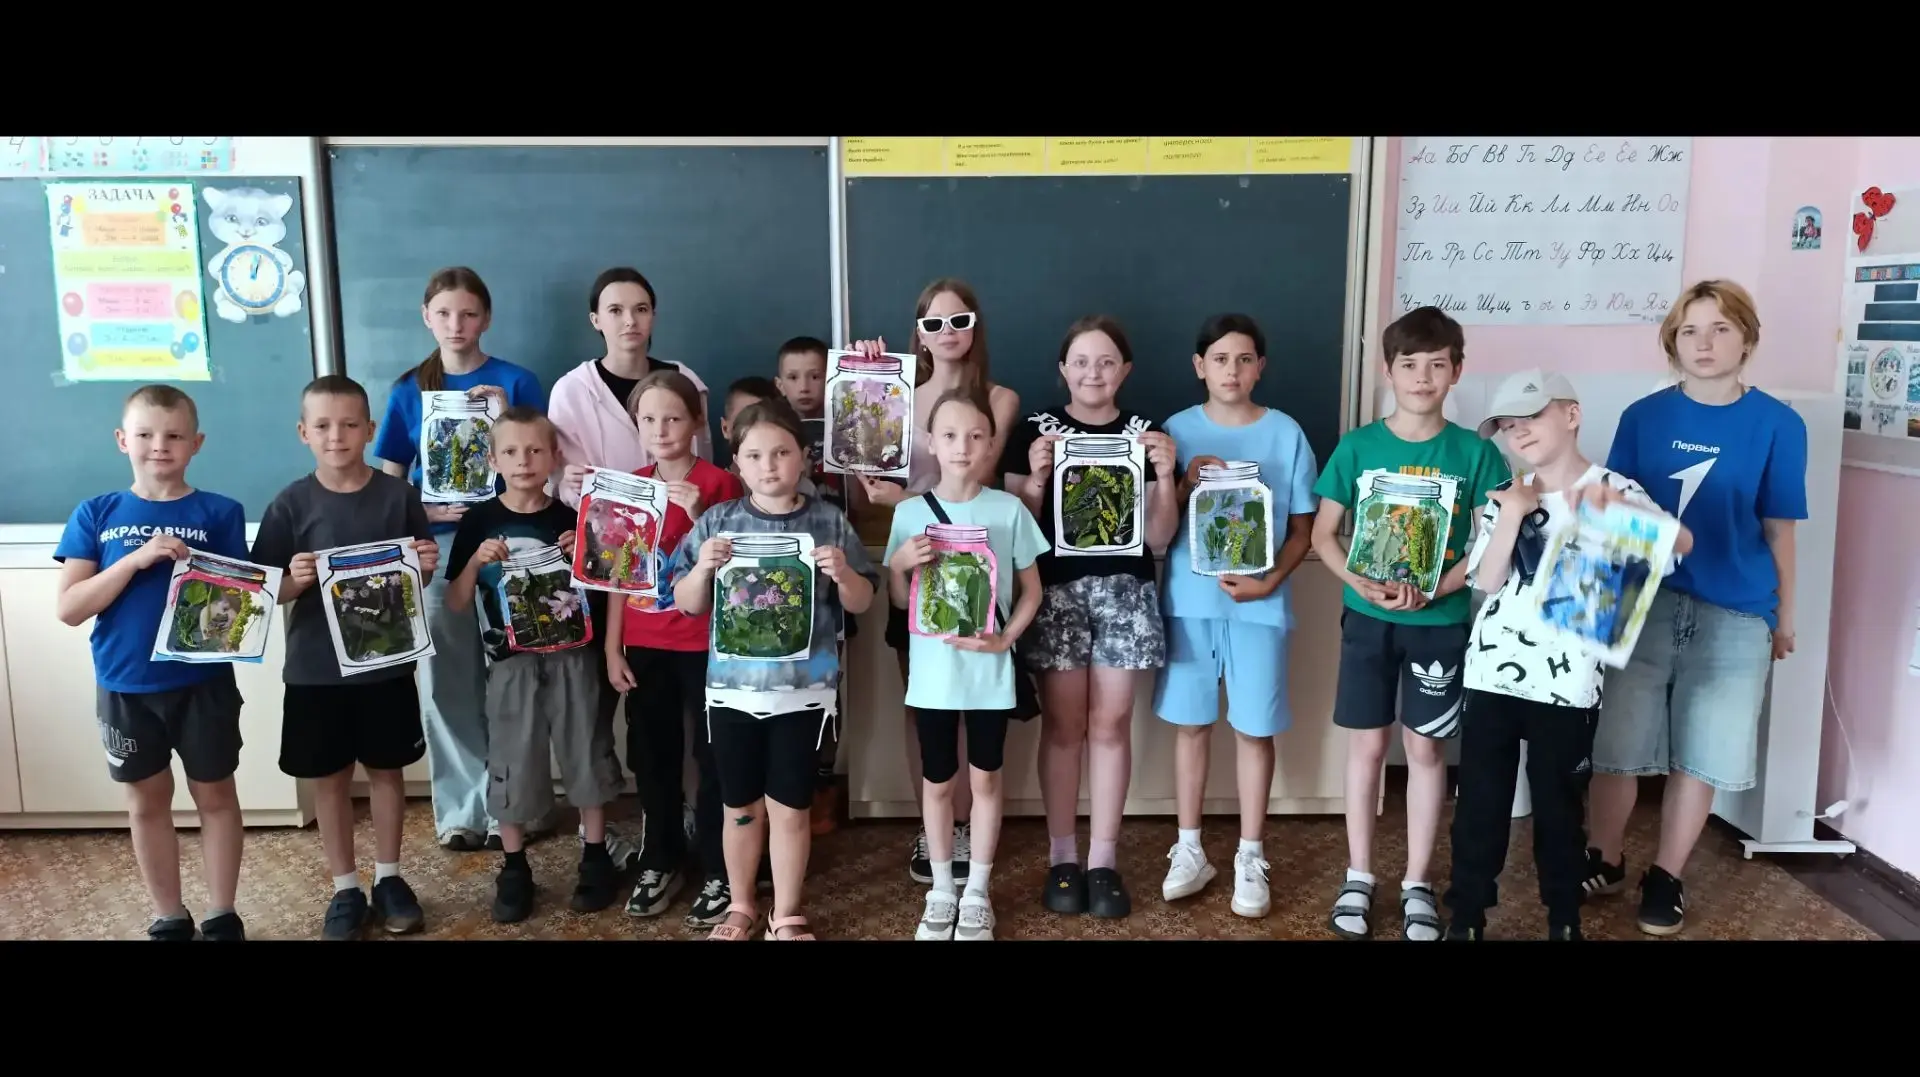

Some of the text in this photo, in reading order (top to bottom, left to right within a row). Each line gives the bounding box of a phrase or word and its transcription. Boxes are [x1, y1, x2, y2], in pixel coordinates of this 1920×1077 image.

[1407, 144, 1436, 164] Аа
[1445, 144, 1479, 164] Бб
[1482, 144, 1509, 164] Вв
[1516, 144, 1536, 164] Гг
[1544, 144, 1575, 171] Дд
[1583, 143, 1606, 163] Ее
[1647, 144, 1684, 163] Жж
[88, 188, 155, 202] ЗАДАЧА
[1405, 191, 1680, 220] Зз Ии Йй Кк Лл Мм Нн Оо
[1402, 241, 1674, 269] Пп Рр Сс Тт Уу Фф Хх Цц
[1432, 293, 1468, 311] Шш
[1476, 292, 1511, 314] Щщ
[1642, 292, 1669, 311] Яя
[1672, 440, 1720, 454] Первые
[1431, 471, 1467, 484] CONCEPT
[100, 525, 208, 543] #КРАСАВЧИК
[1419, 687, 1447, 697] adidas
